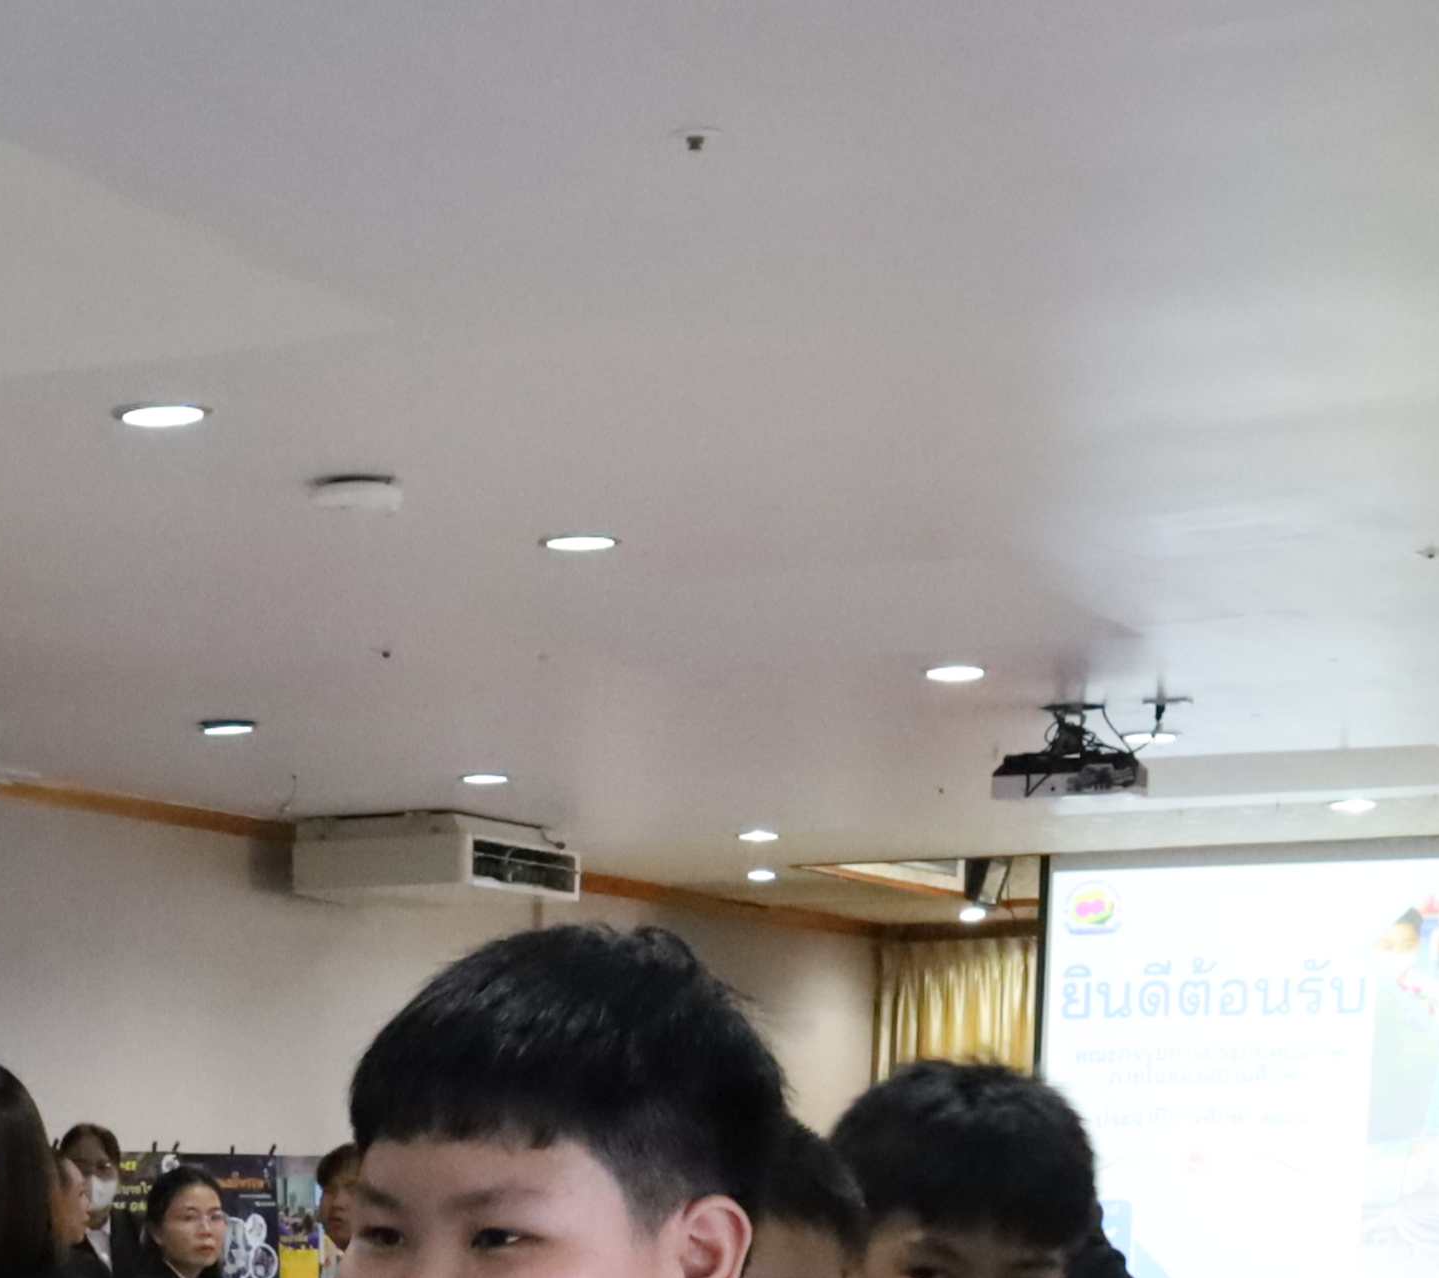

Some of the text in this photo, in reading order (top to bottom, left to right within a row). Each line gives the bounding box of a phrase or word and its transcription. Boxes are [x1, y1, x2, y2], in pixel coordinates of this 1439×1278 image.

[1060, 957, 1366, 1021] ยินดีต้อนรับ
